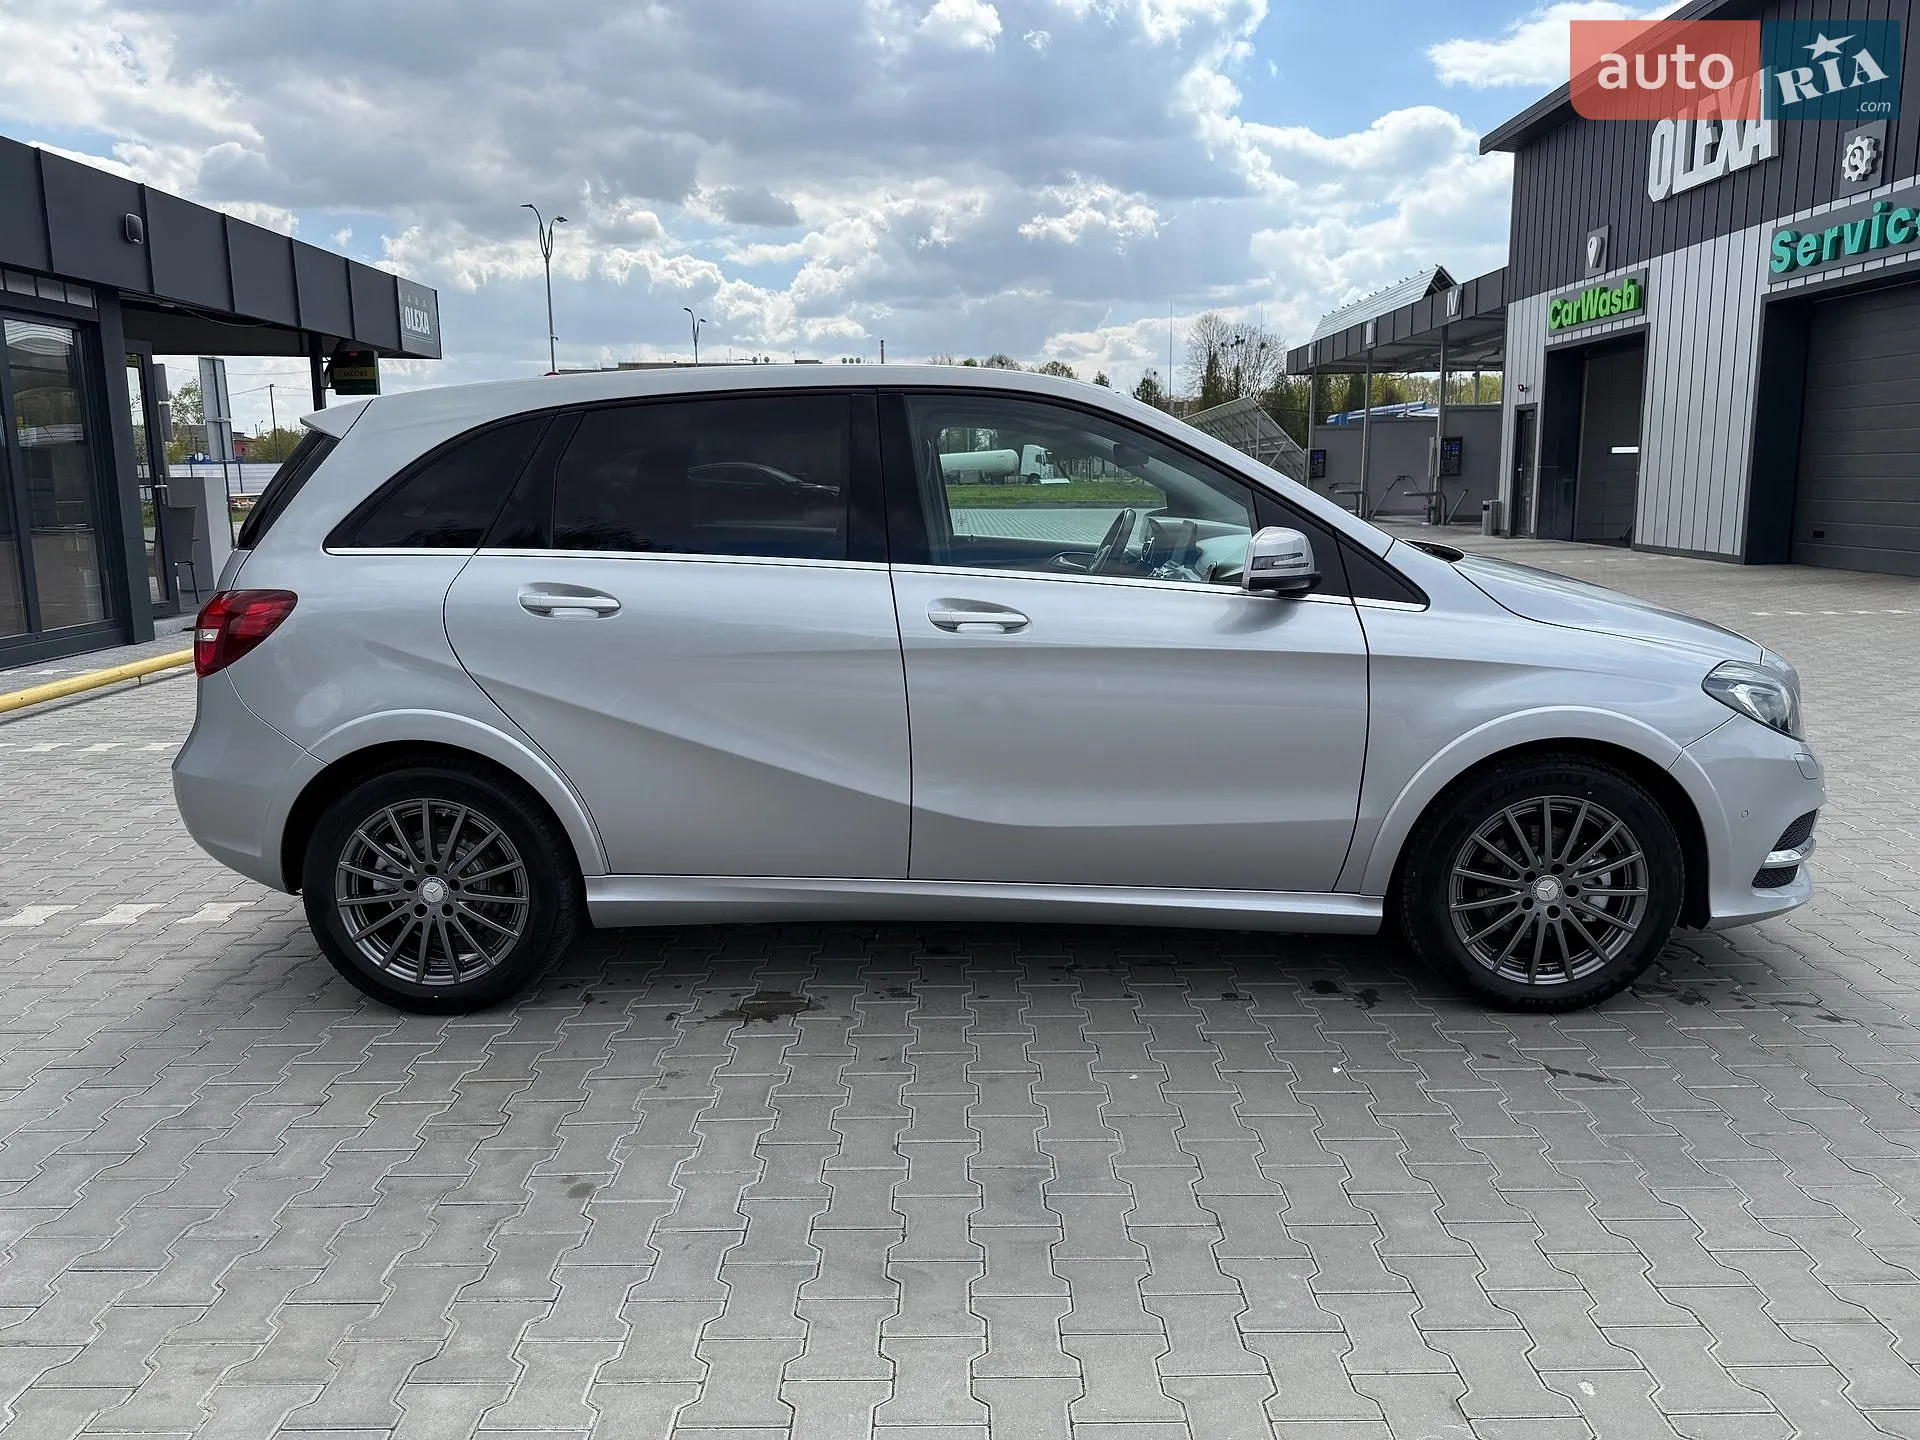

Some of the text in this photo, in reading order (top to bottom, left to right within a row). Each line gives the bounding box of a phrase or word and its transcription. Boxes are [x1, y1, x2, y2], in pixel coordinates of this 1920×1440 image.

[1648, 65, 1778, 202] OLEXA
[1770, 201, 1920, 273] Servic
[404, 306, 430, 335] OLEXA
[1549, 278, 1640, 330] CarWash
